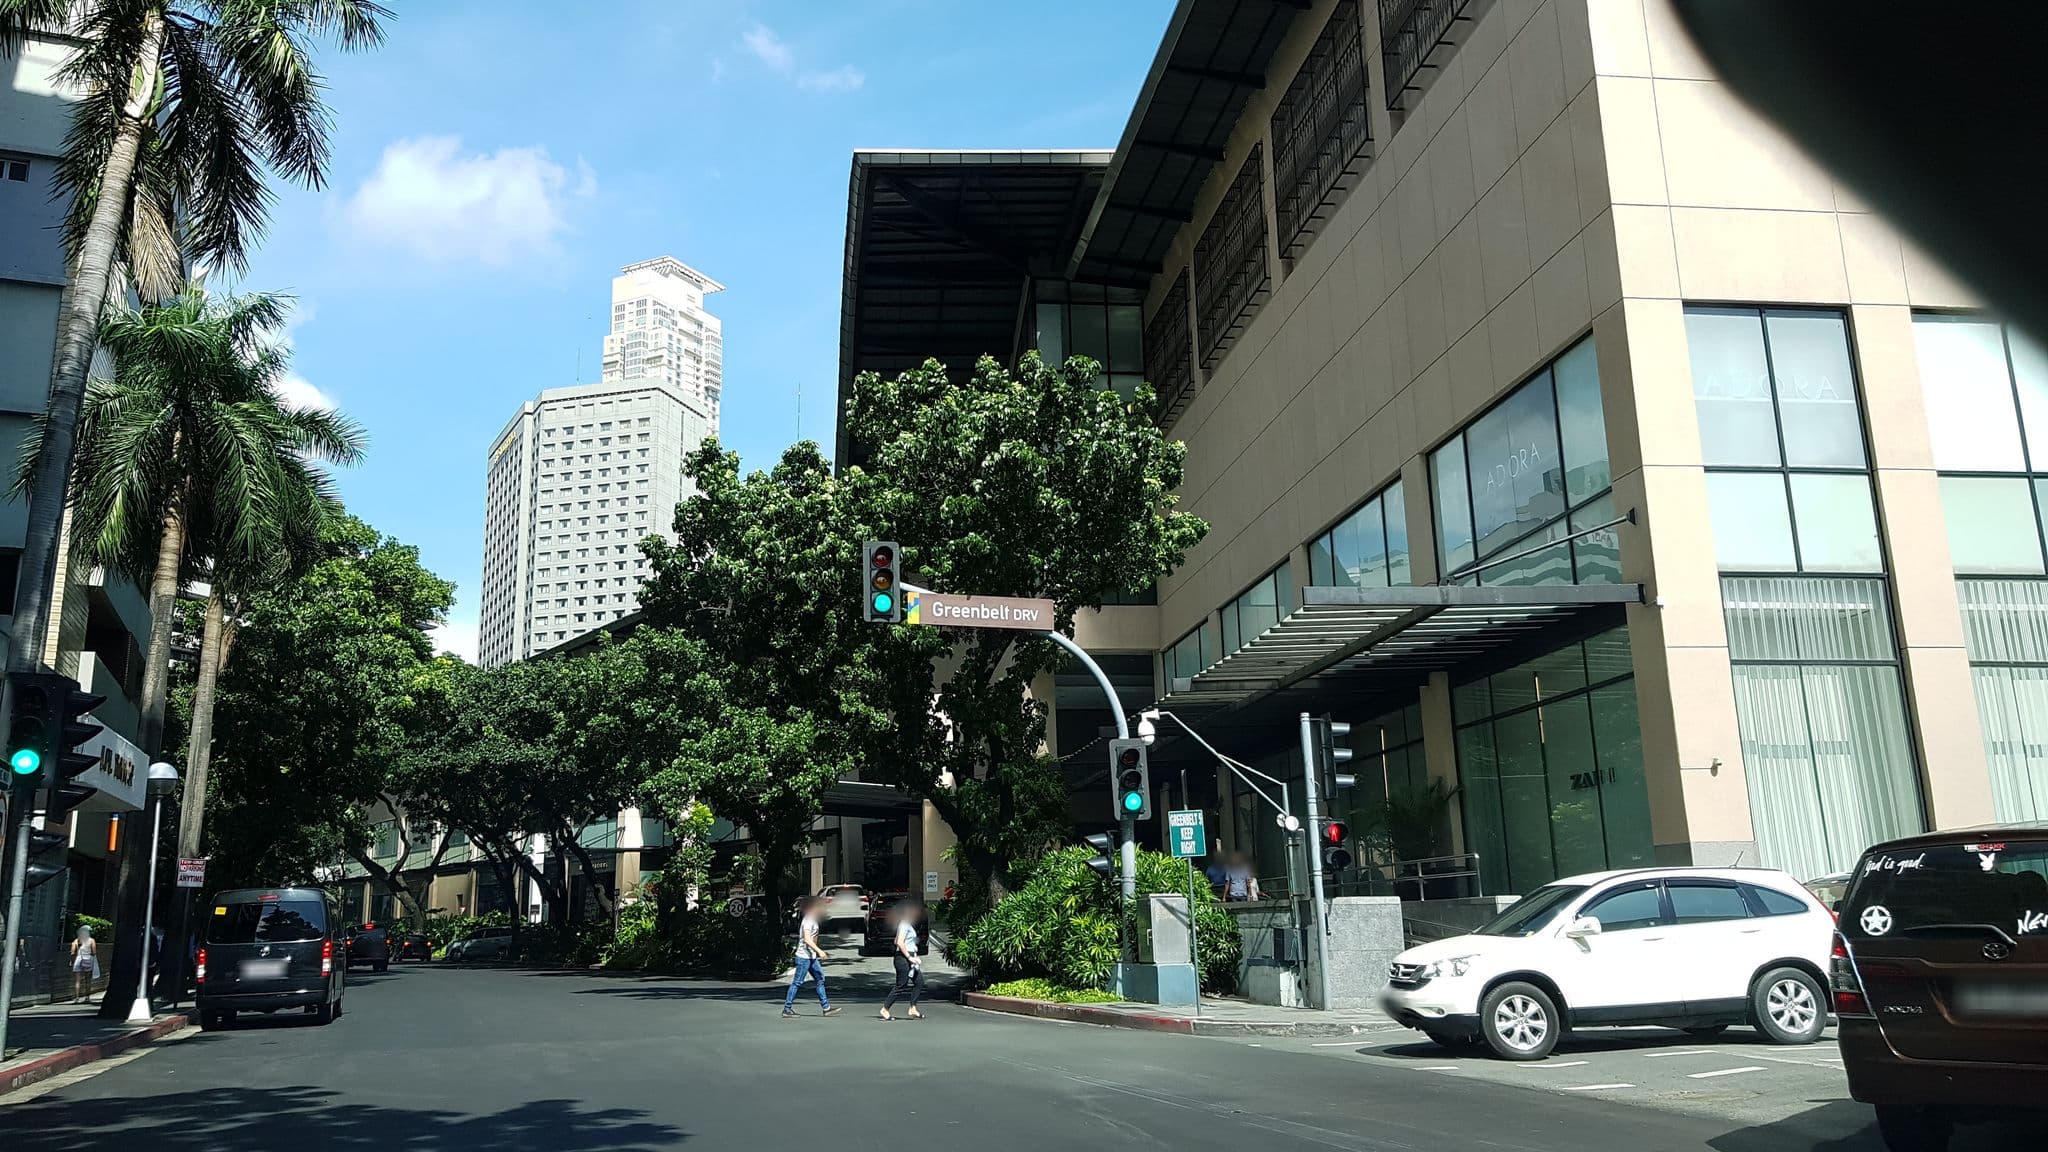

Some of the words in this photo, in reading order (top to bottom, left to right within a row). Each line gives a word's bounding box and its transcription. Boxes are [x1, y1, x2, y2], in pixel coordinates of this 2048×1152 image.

[1702, 373, 1842, 400] ADORA
[1486, 442, 1541, 493] ADORA
[932, 601, 1010, 621] Greenbelt
[1013, 608, 1039, 621] DRV
[1169, 812, 1198, 826] GREENBELT
[1181, 827, 1194, 840] KEEP
[1180, 840, 1196, 854] RIGHT
[1884, 857, 1895, 870] is
[731, 903, 743, 913] 20
